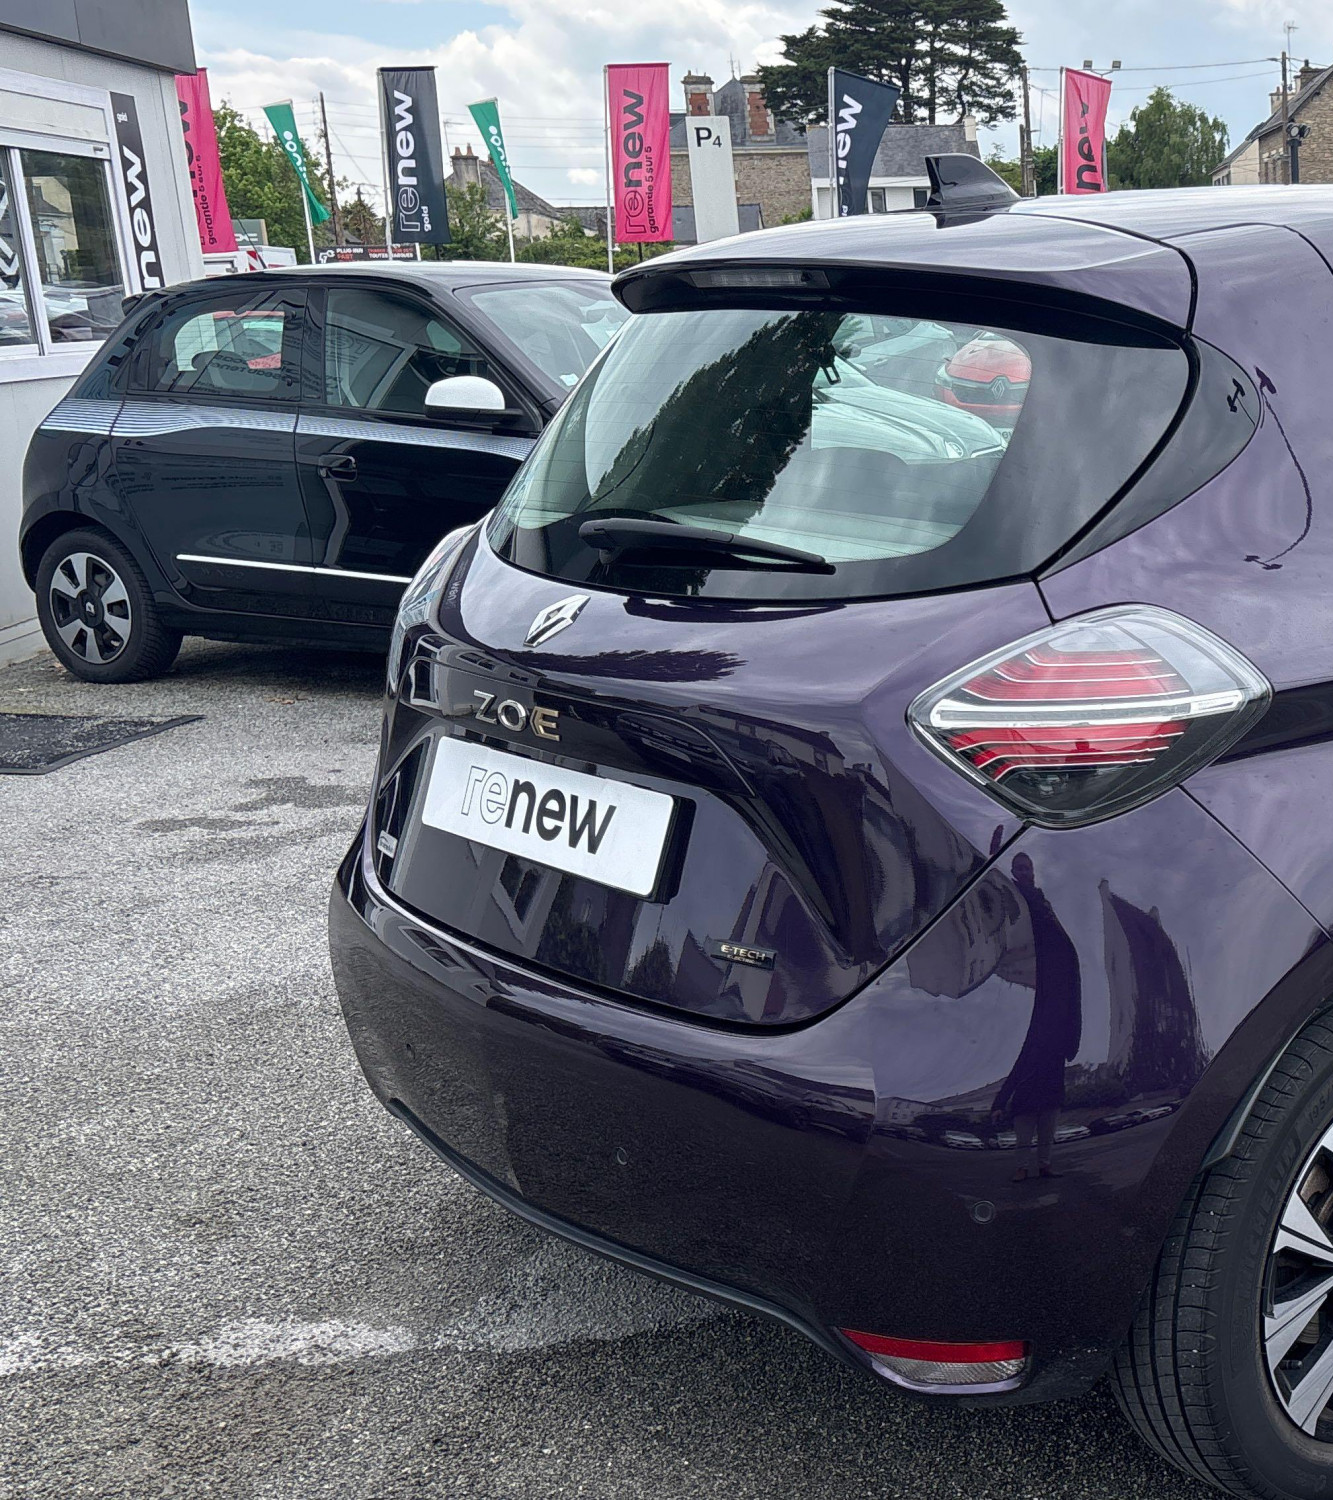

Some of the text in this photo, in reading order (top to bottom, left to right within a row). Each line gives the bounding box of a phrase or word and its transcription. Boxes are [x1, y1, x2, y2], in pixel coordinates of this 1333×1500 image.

[394, 89, 420, 232] renew
[623, 89, 646, 234] renew
[420, 205, 432, 232] gold
[473, 689, 561, 742] ZOE
[461, 765, 617, 855] renew
[720, 944, 767, 961] E-TECH
